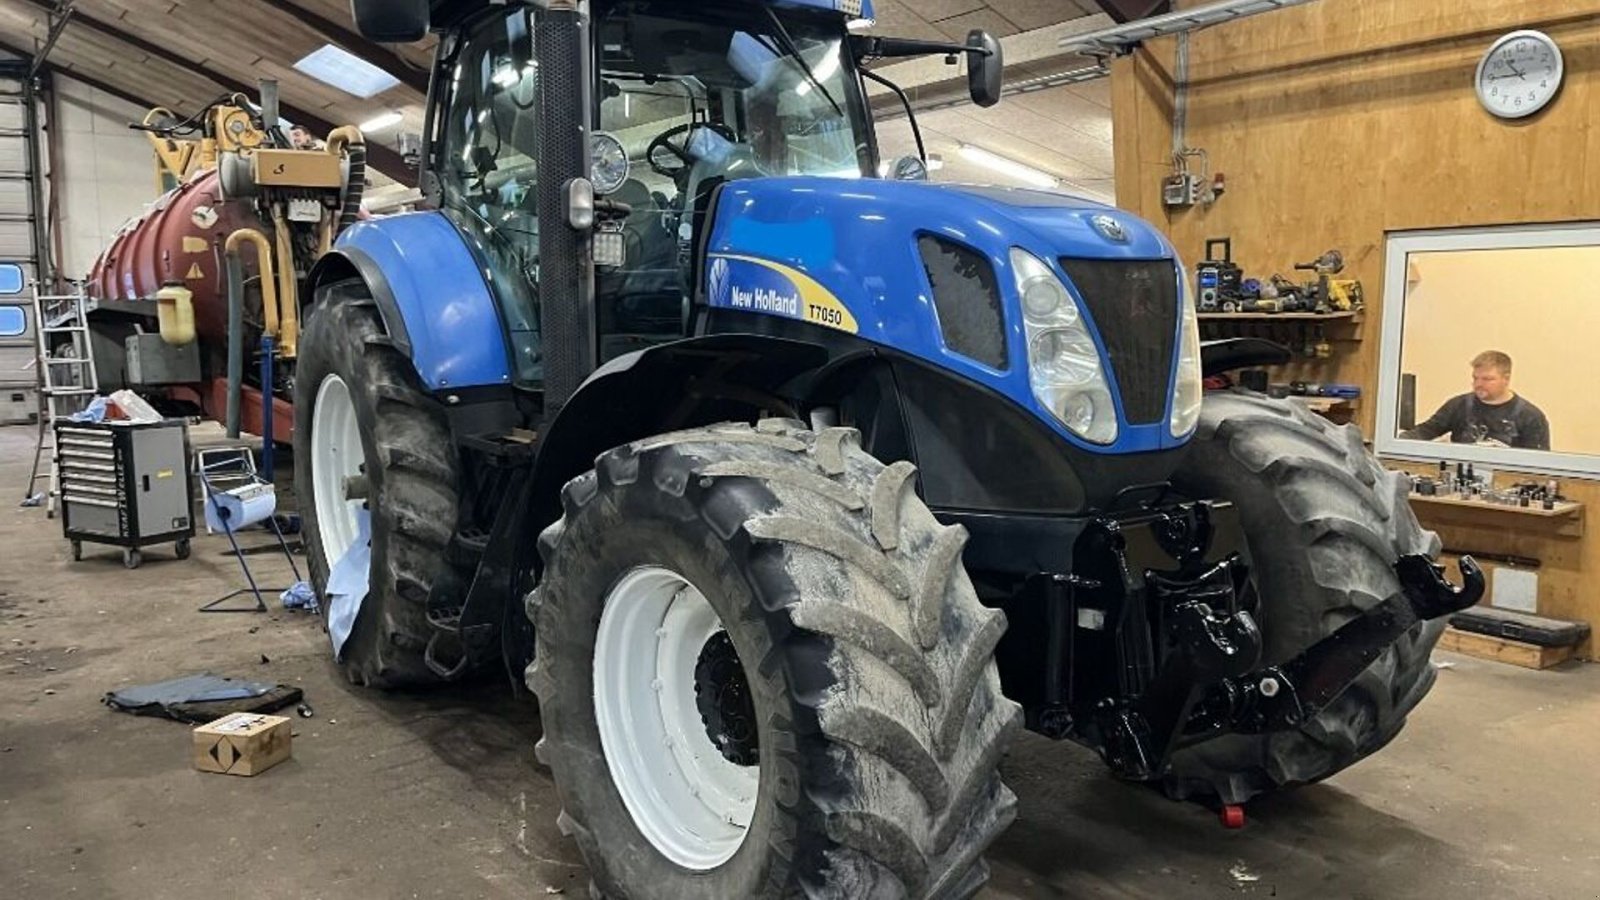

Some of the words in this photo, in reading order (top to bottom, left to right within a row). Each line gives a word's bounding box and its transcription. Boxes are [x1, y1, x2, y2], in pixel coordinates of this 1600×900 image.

[1515, 42, 1526, 53] 12
[1503, 49, 1512, 58] 11
[1540, 52, 1549, 62] 2
[1493, 60, 1504, 70] 10
[1544, 65, 1552, 75] 3
[1540, 80, 1547, 88] 4
[1491, 86, 1498, 97] 8
[1529, 90, 1536, 101] 5
[1502, 95, 1509, 104] 7
[1514, 96, 1522, 106] 6
[731, 286, 753, 306] New
[754, 287, 798, 315] Holland
[809, 304, 842, 325] T7050
